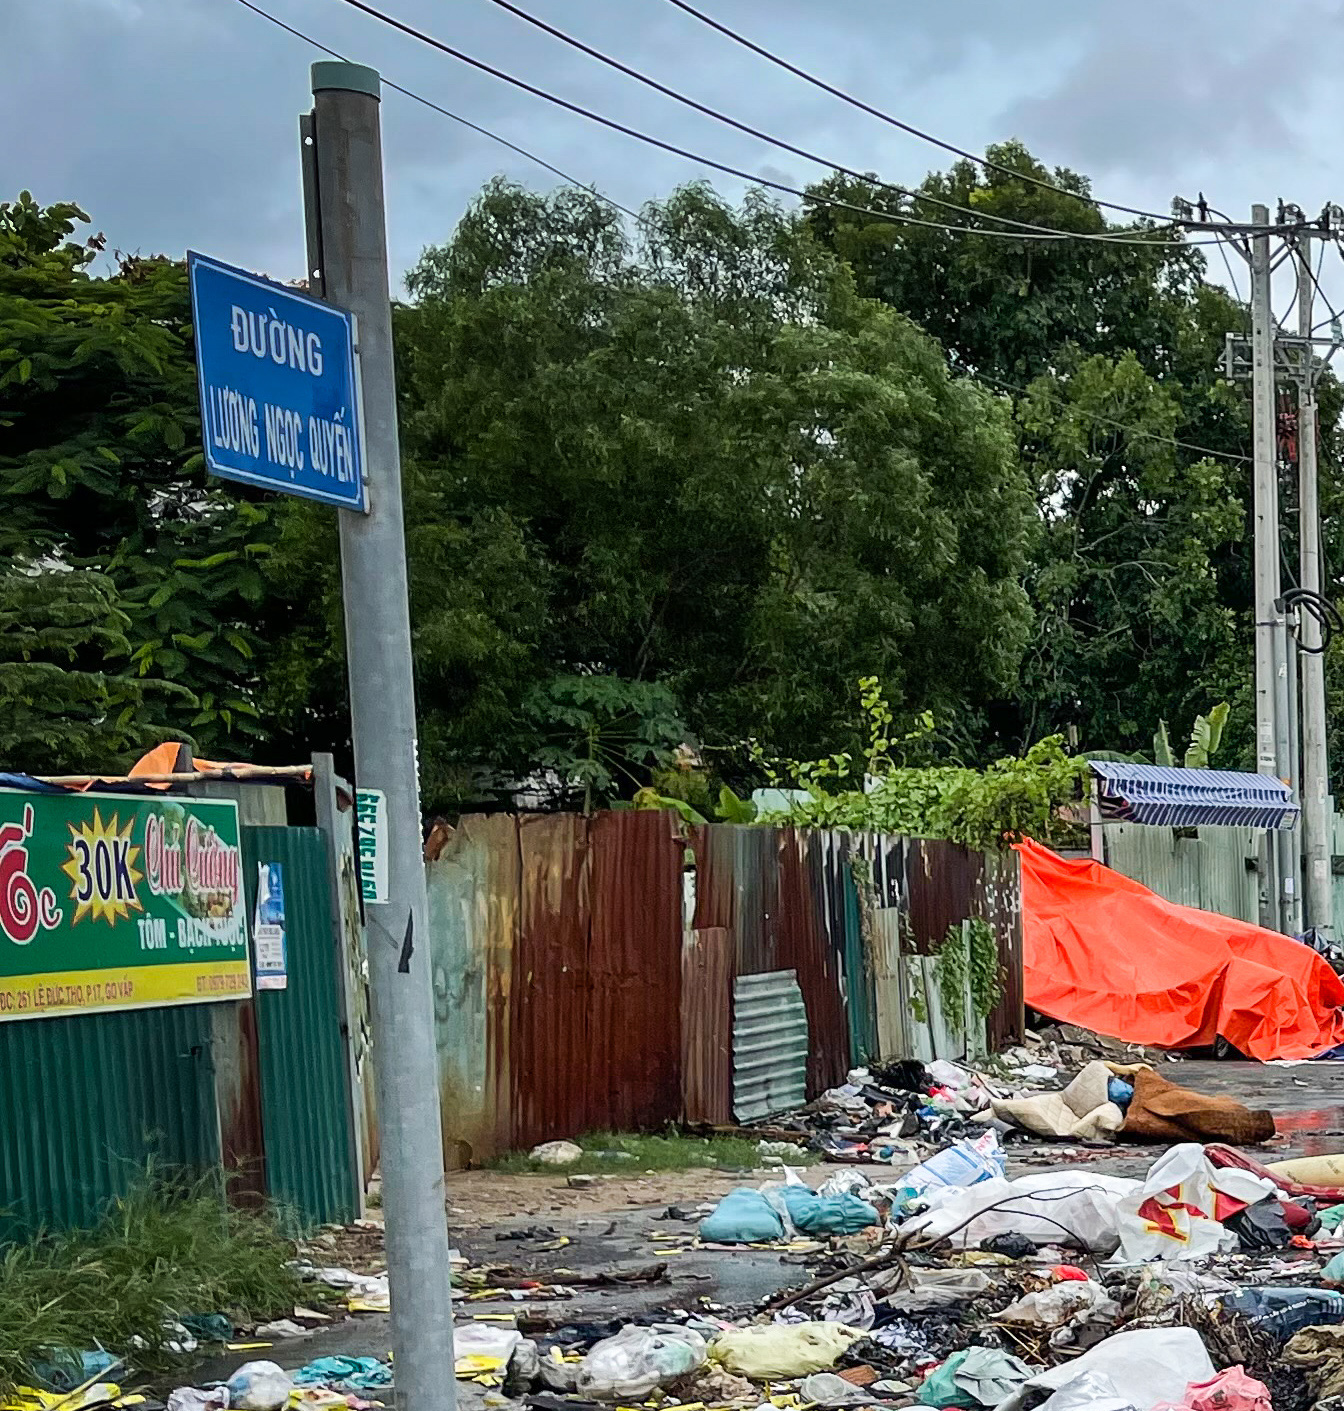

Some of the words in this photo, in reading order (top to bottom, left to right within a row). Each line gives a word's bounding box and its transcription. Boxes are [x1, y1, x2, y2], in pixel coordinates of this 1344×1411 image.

[230, 304, 324, 377] ĐƯỜNG
[209, 384, 260, 460] LƯƠNG
[264, 402, 304, 479] NGỌC
[308, 406, 356, 483] QUYẾN
[75, 837, 136, 903] 30K
[137, 912, 168, 950] TÔM
